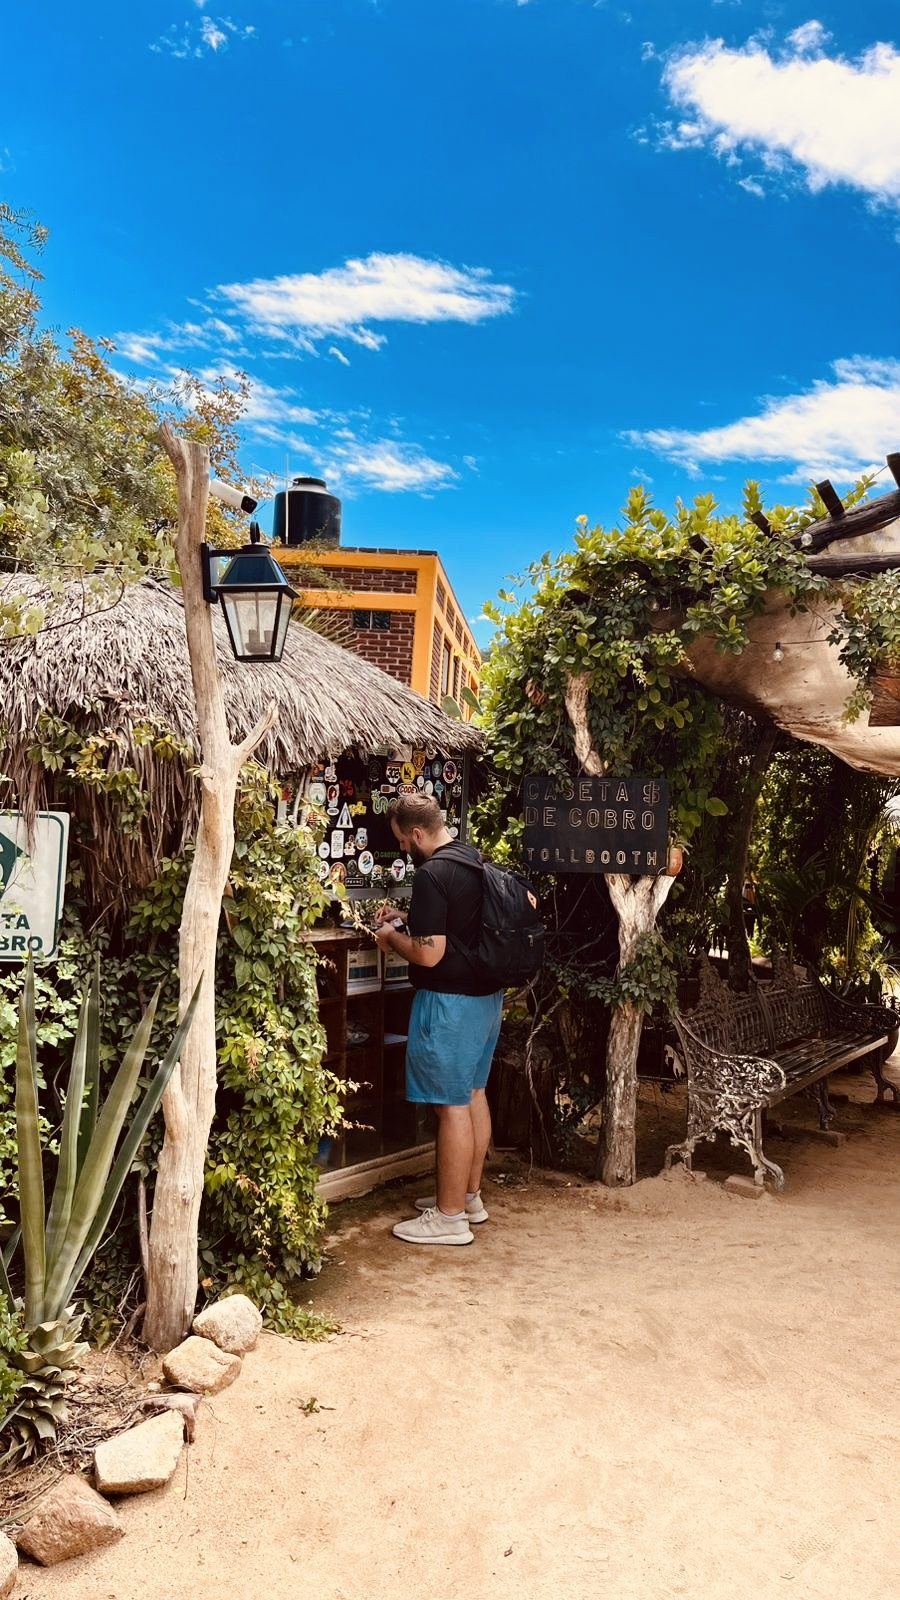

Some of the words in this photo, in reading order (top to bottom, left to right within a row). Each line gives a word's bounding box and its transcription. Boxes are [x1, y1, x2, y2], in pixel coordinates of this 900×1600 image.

[527, 780, 629, 802] CASETA
[525, 806, 556, 827] DE
[569, 807, 655, 831] COBRO
[526, 847, 657, 866] TOLLBOOTH
